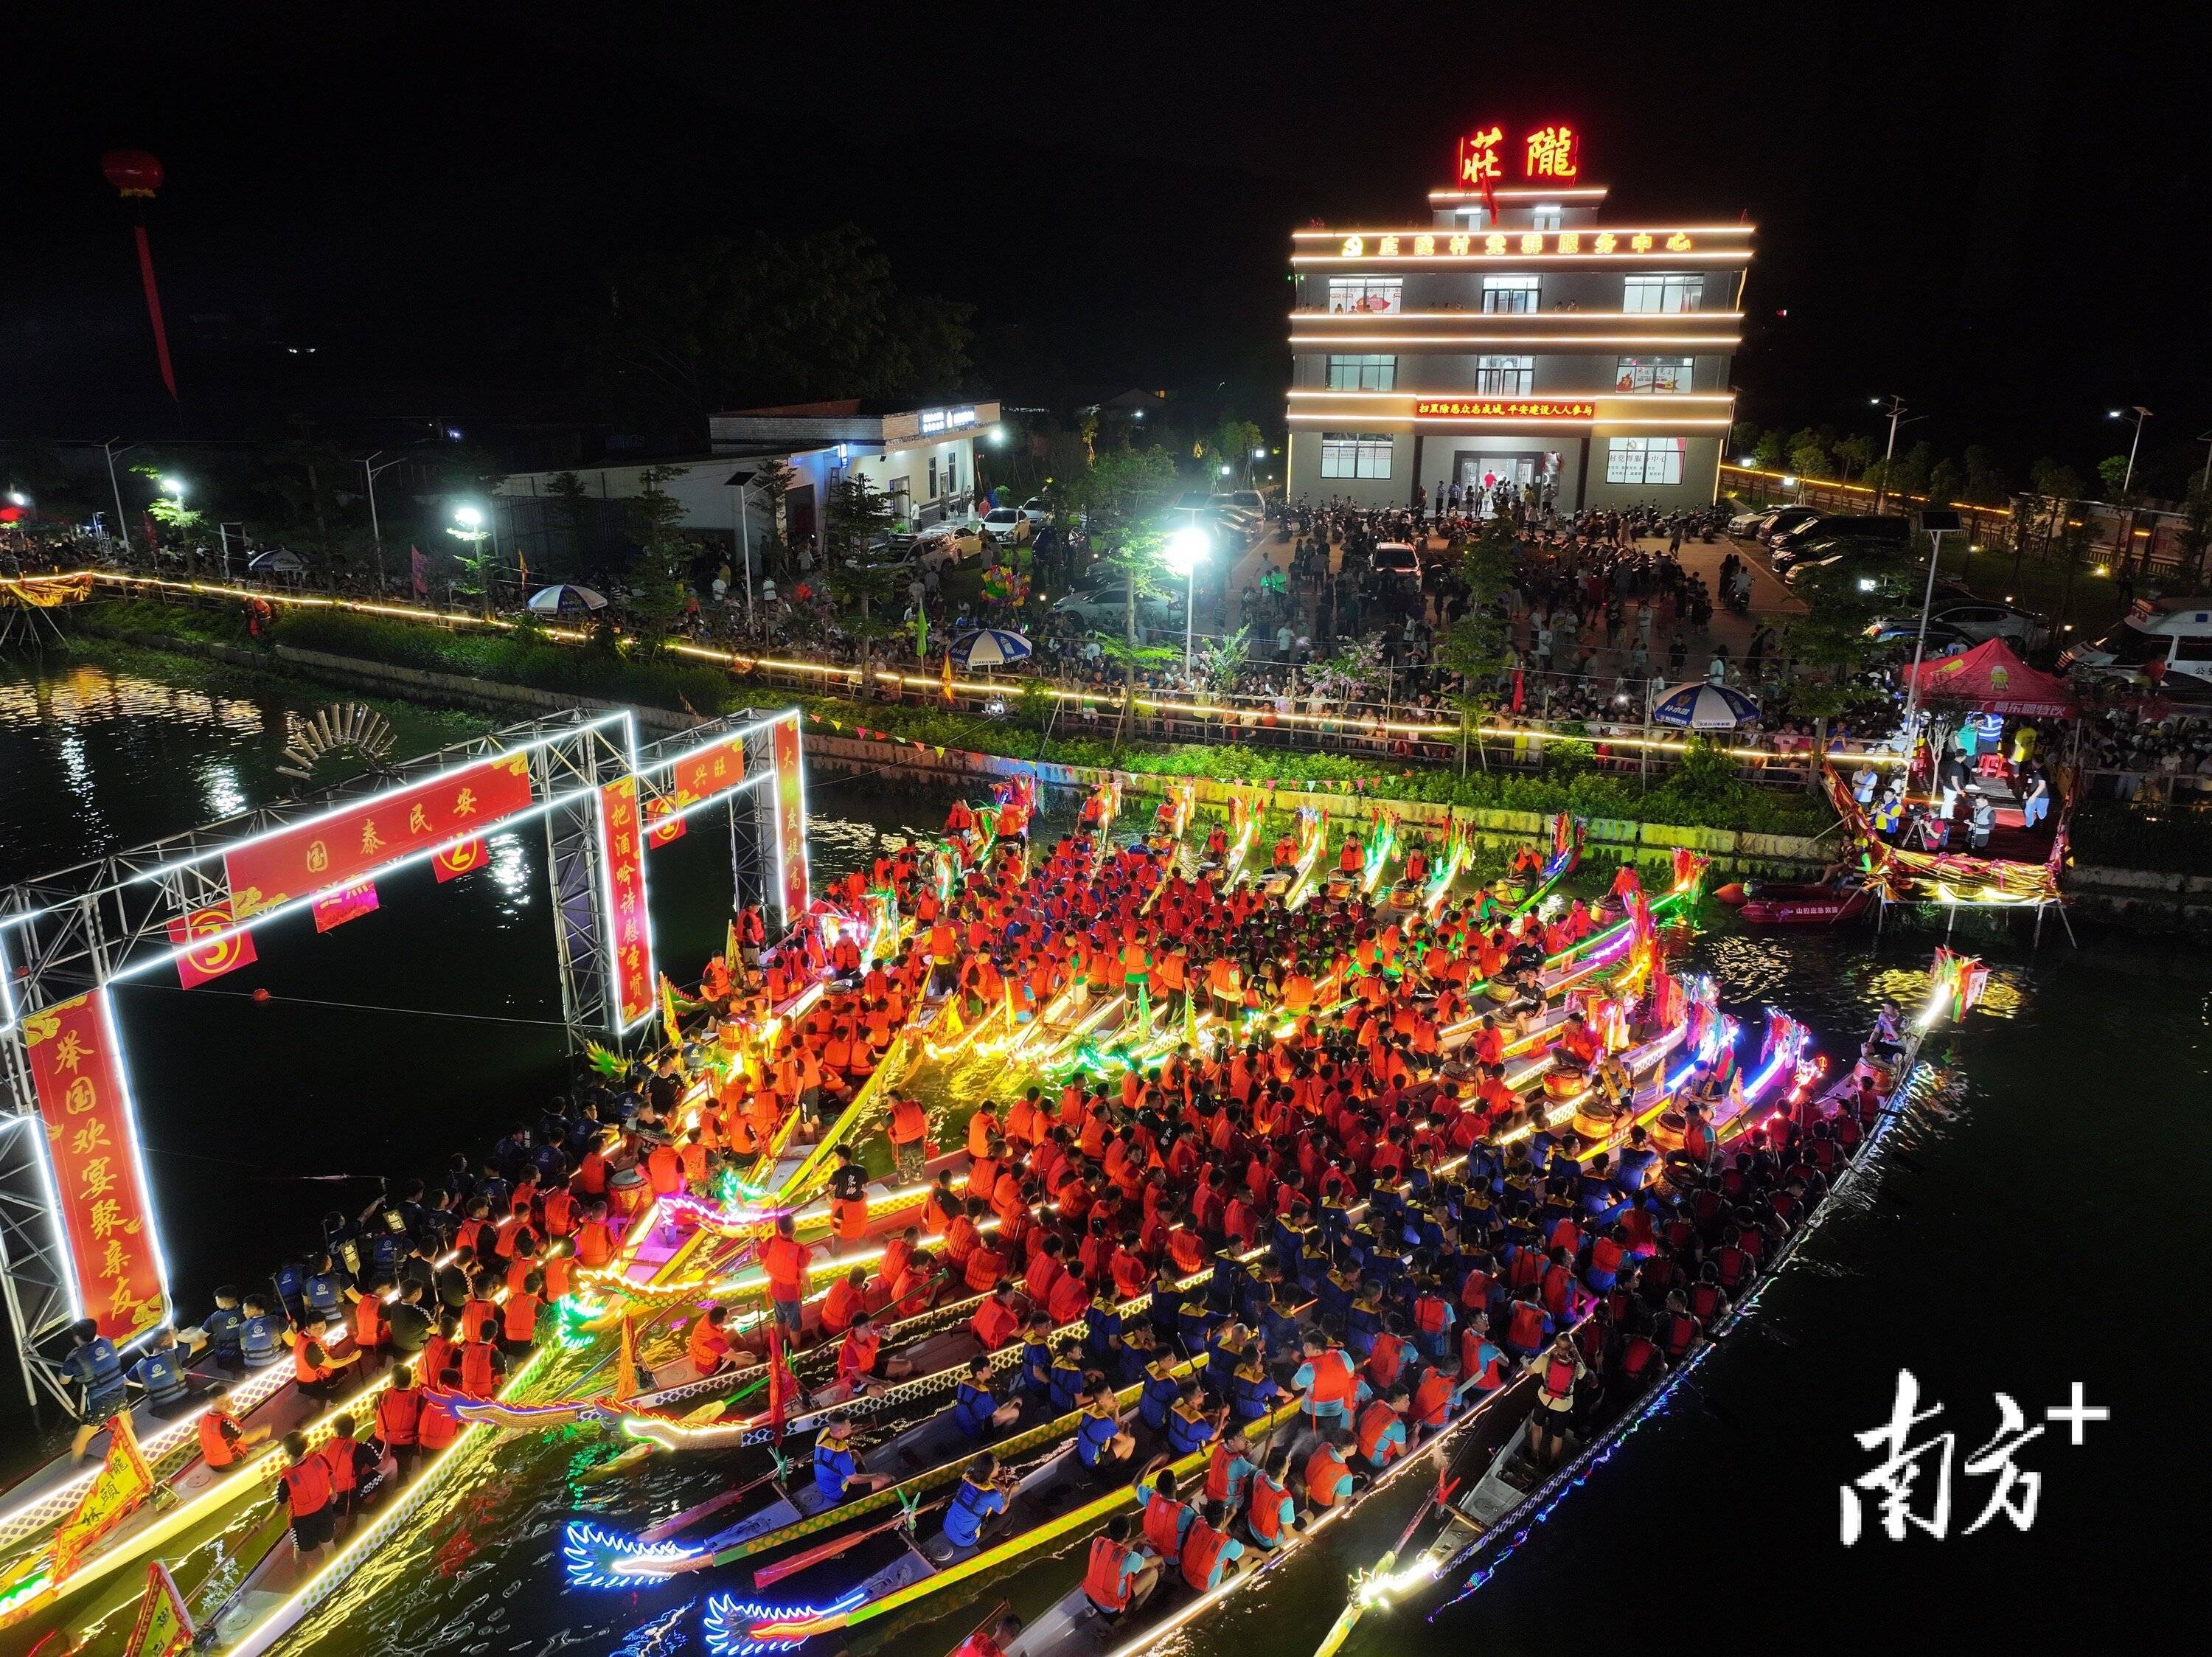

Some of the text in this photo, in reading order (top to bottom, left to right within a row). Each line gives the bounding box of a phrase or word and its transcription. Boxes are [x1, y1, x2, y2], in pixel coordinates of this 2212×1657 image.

[1378, 232, 1691, 255] 庄陇村党群服务中心
[693, 756, 726, 789] 兴旺
[306, 788, 478, 873] 国泰民安
[611, 804, 643, 999] 把酒吟诗慰圣贤
[55, 1029, 144, 1321] 举国欢宴聚亲友
